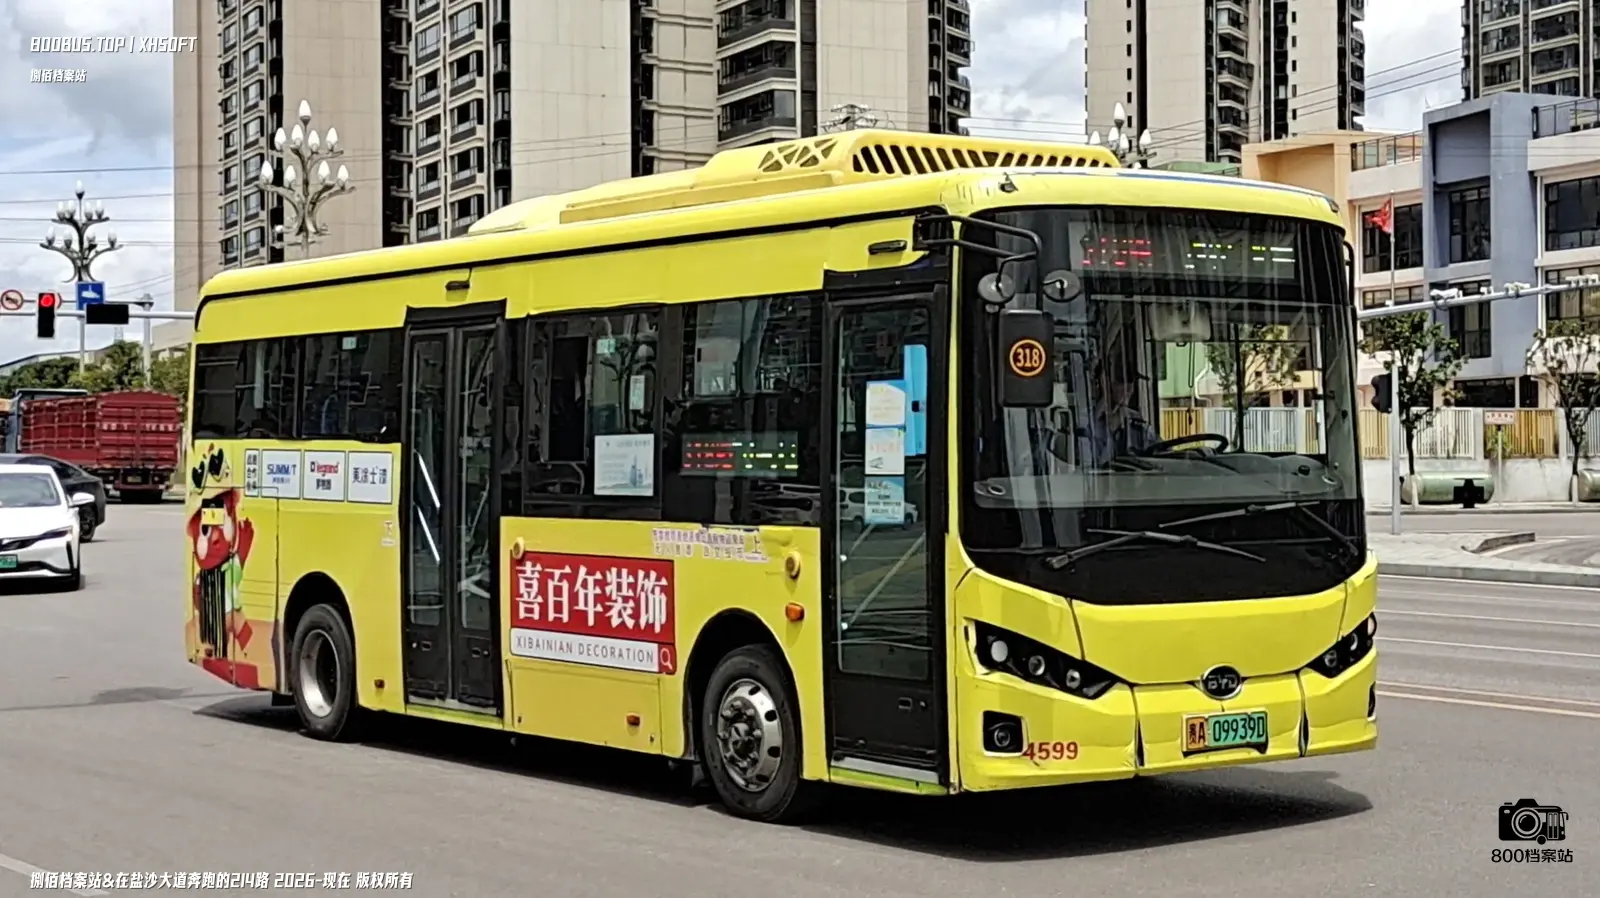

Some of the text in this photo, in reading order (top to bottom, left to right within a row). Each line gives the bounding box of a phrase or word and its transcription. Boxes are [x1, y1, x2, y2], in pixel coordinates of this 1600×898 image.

[1015, 348, 1040, 367] 318
[267, 463, 297, 476] SUMMT
[751, 535, 762, 554] 上
[515, 561, 669, 634] 喜百年装饰
[515, 635, 654, 663] XIBAINIAN DECORATION
[1207, 673, 1239, 691] BYD
[1212, 716, 1265, 743] 09939D
[1023, 741, 1079, 761] 4599
